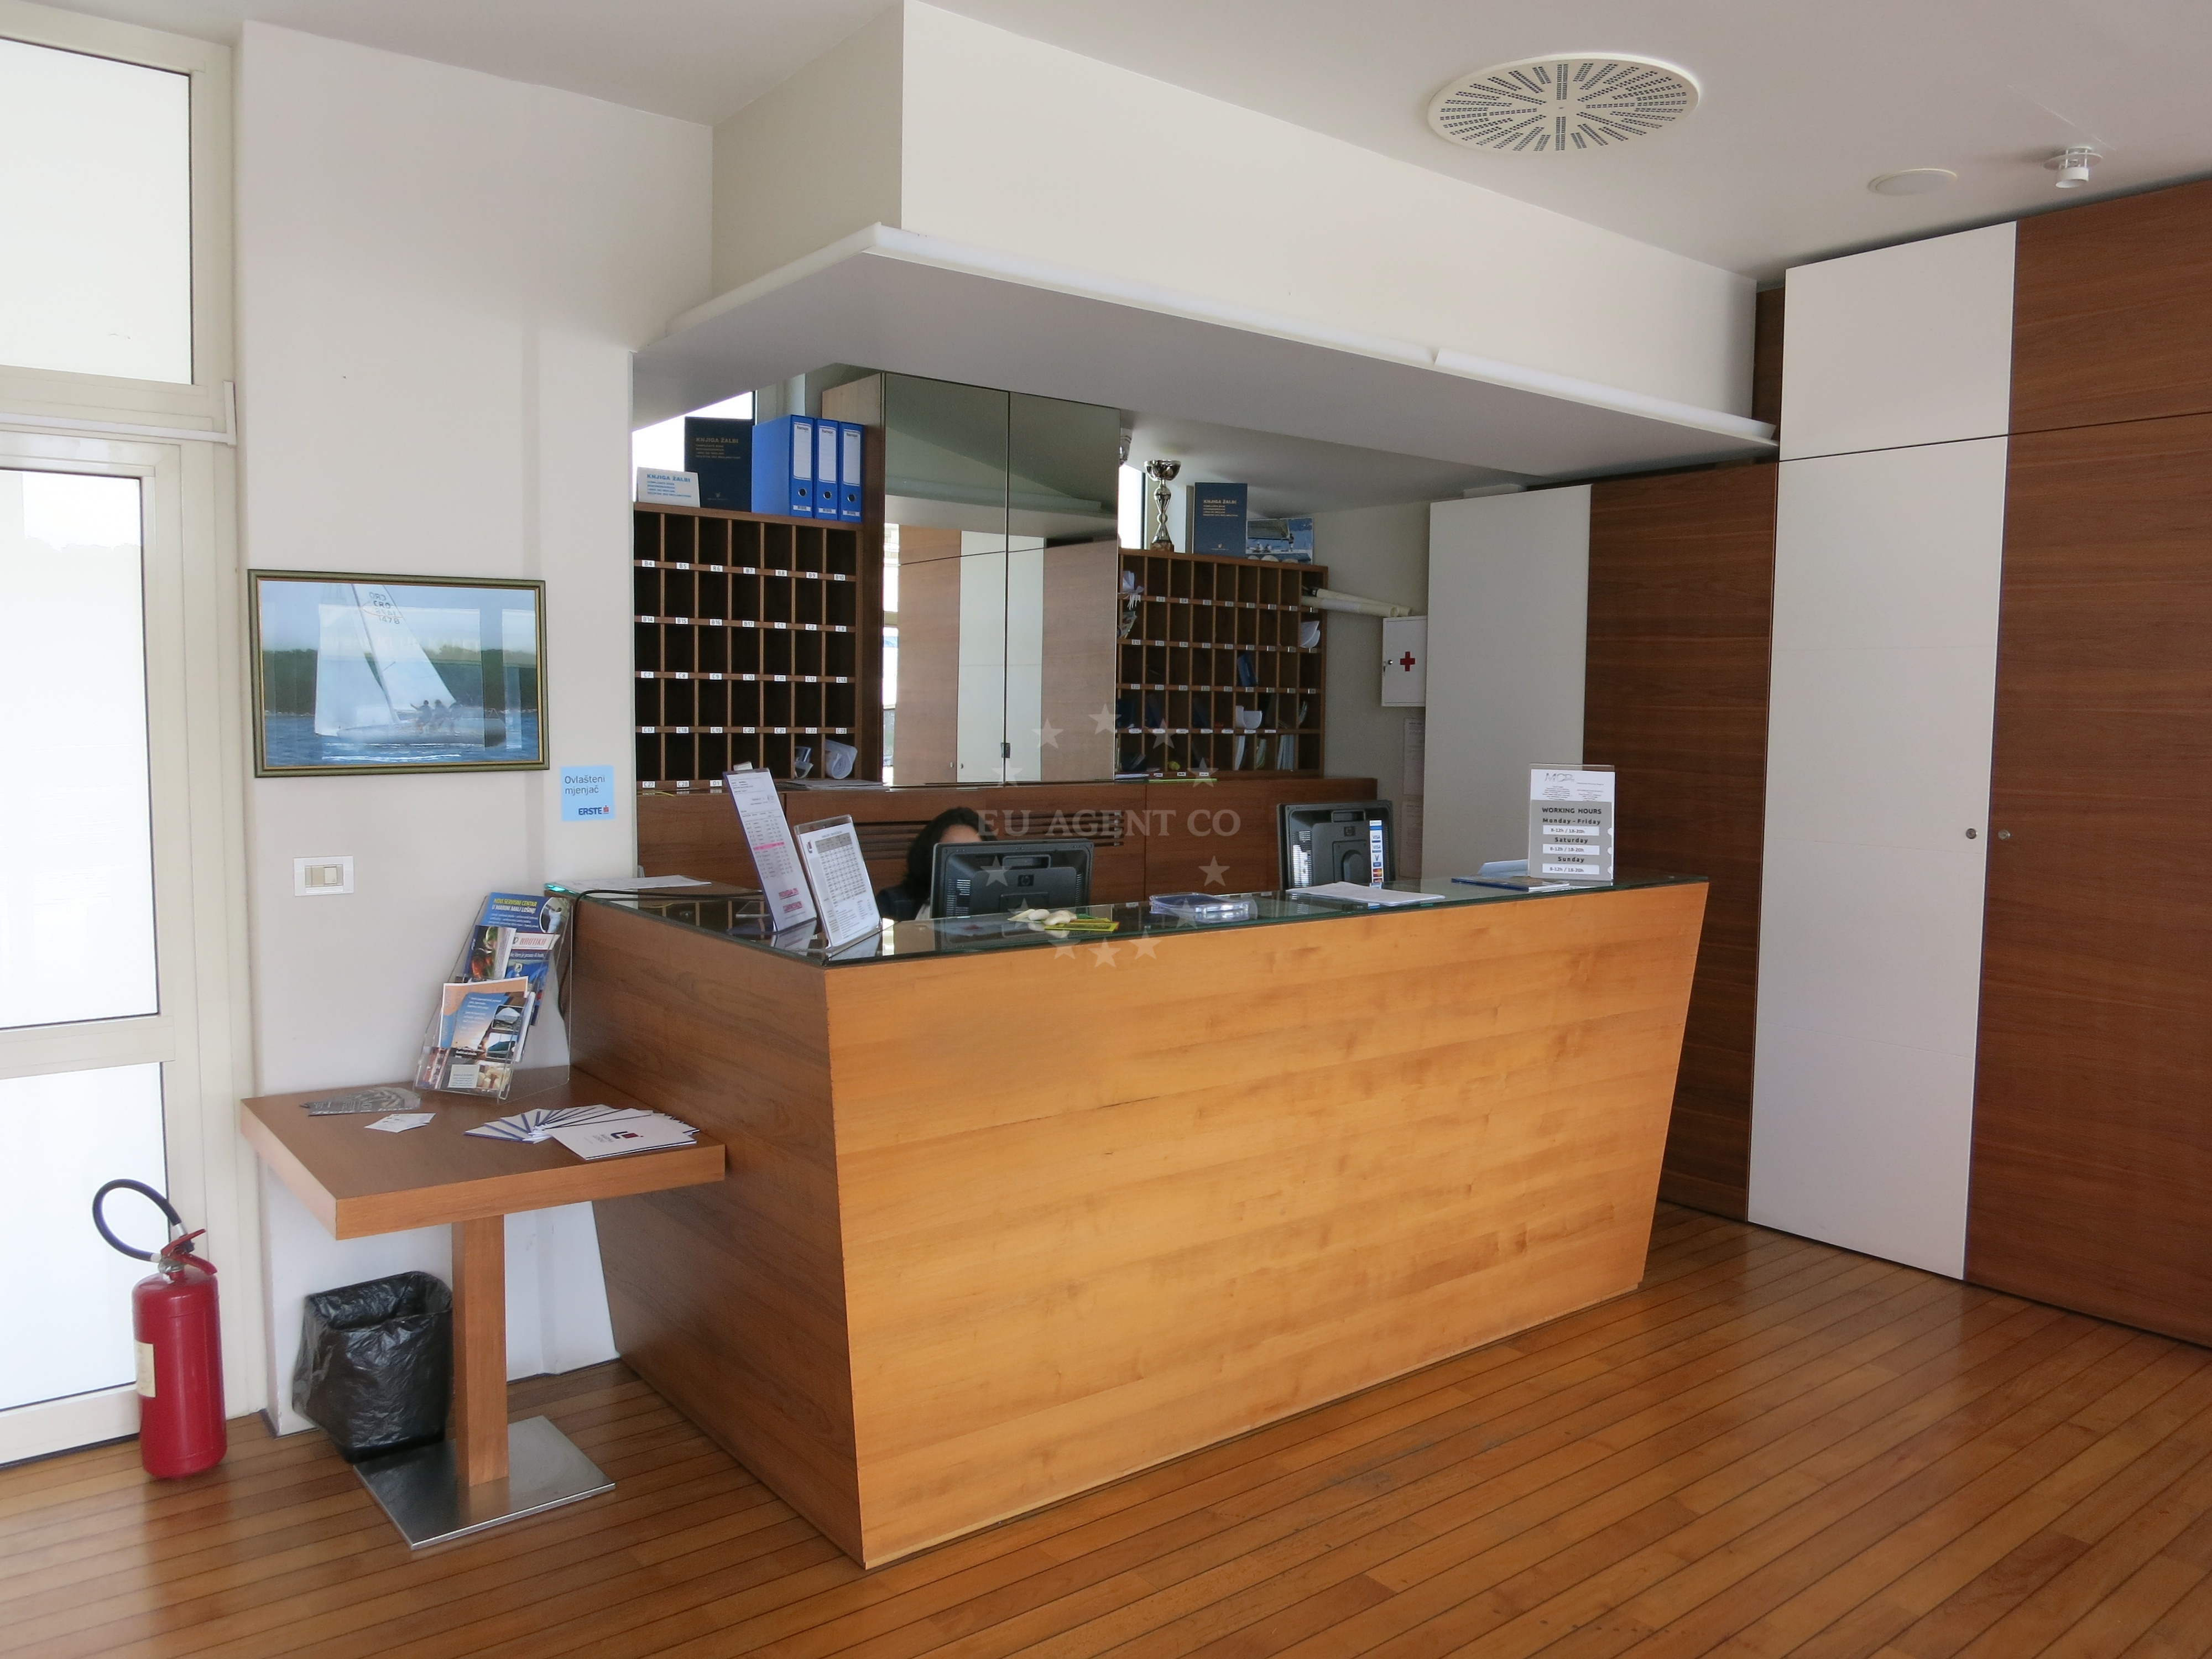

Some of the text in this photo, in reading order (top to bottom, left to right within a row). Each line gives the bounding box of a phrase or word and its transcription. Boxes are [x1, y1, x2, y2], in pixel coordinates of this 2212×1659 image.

[373, 600, 391, 609] CRO
[378, 615, 400, 624] 1478
[565, 775, 605, 784] Ovlašteni
[565, 785, 599, 796] mjenjač
[578, 807, 602, 816] ERSTE
